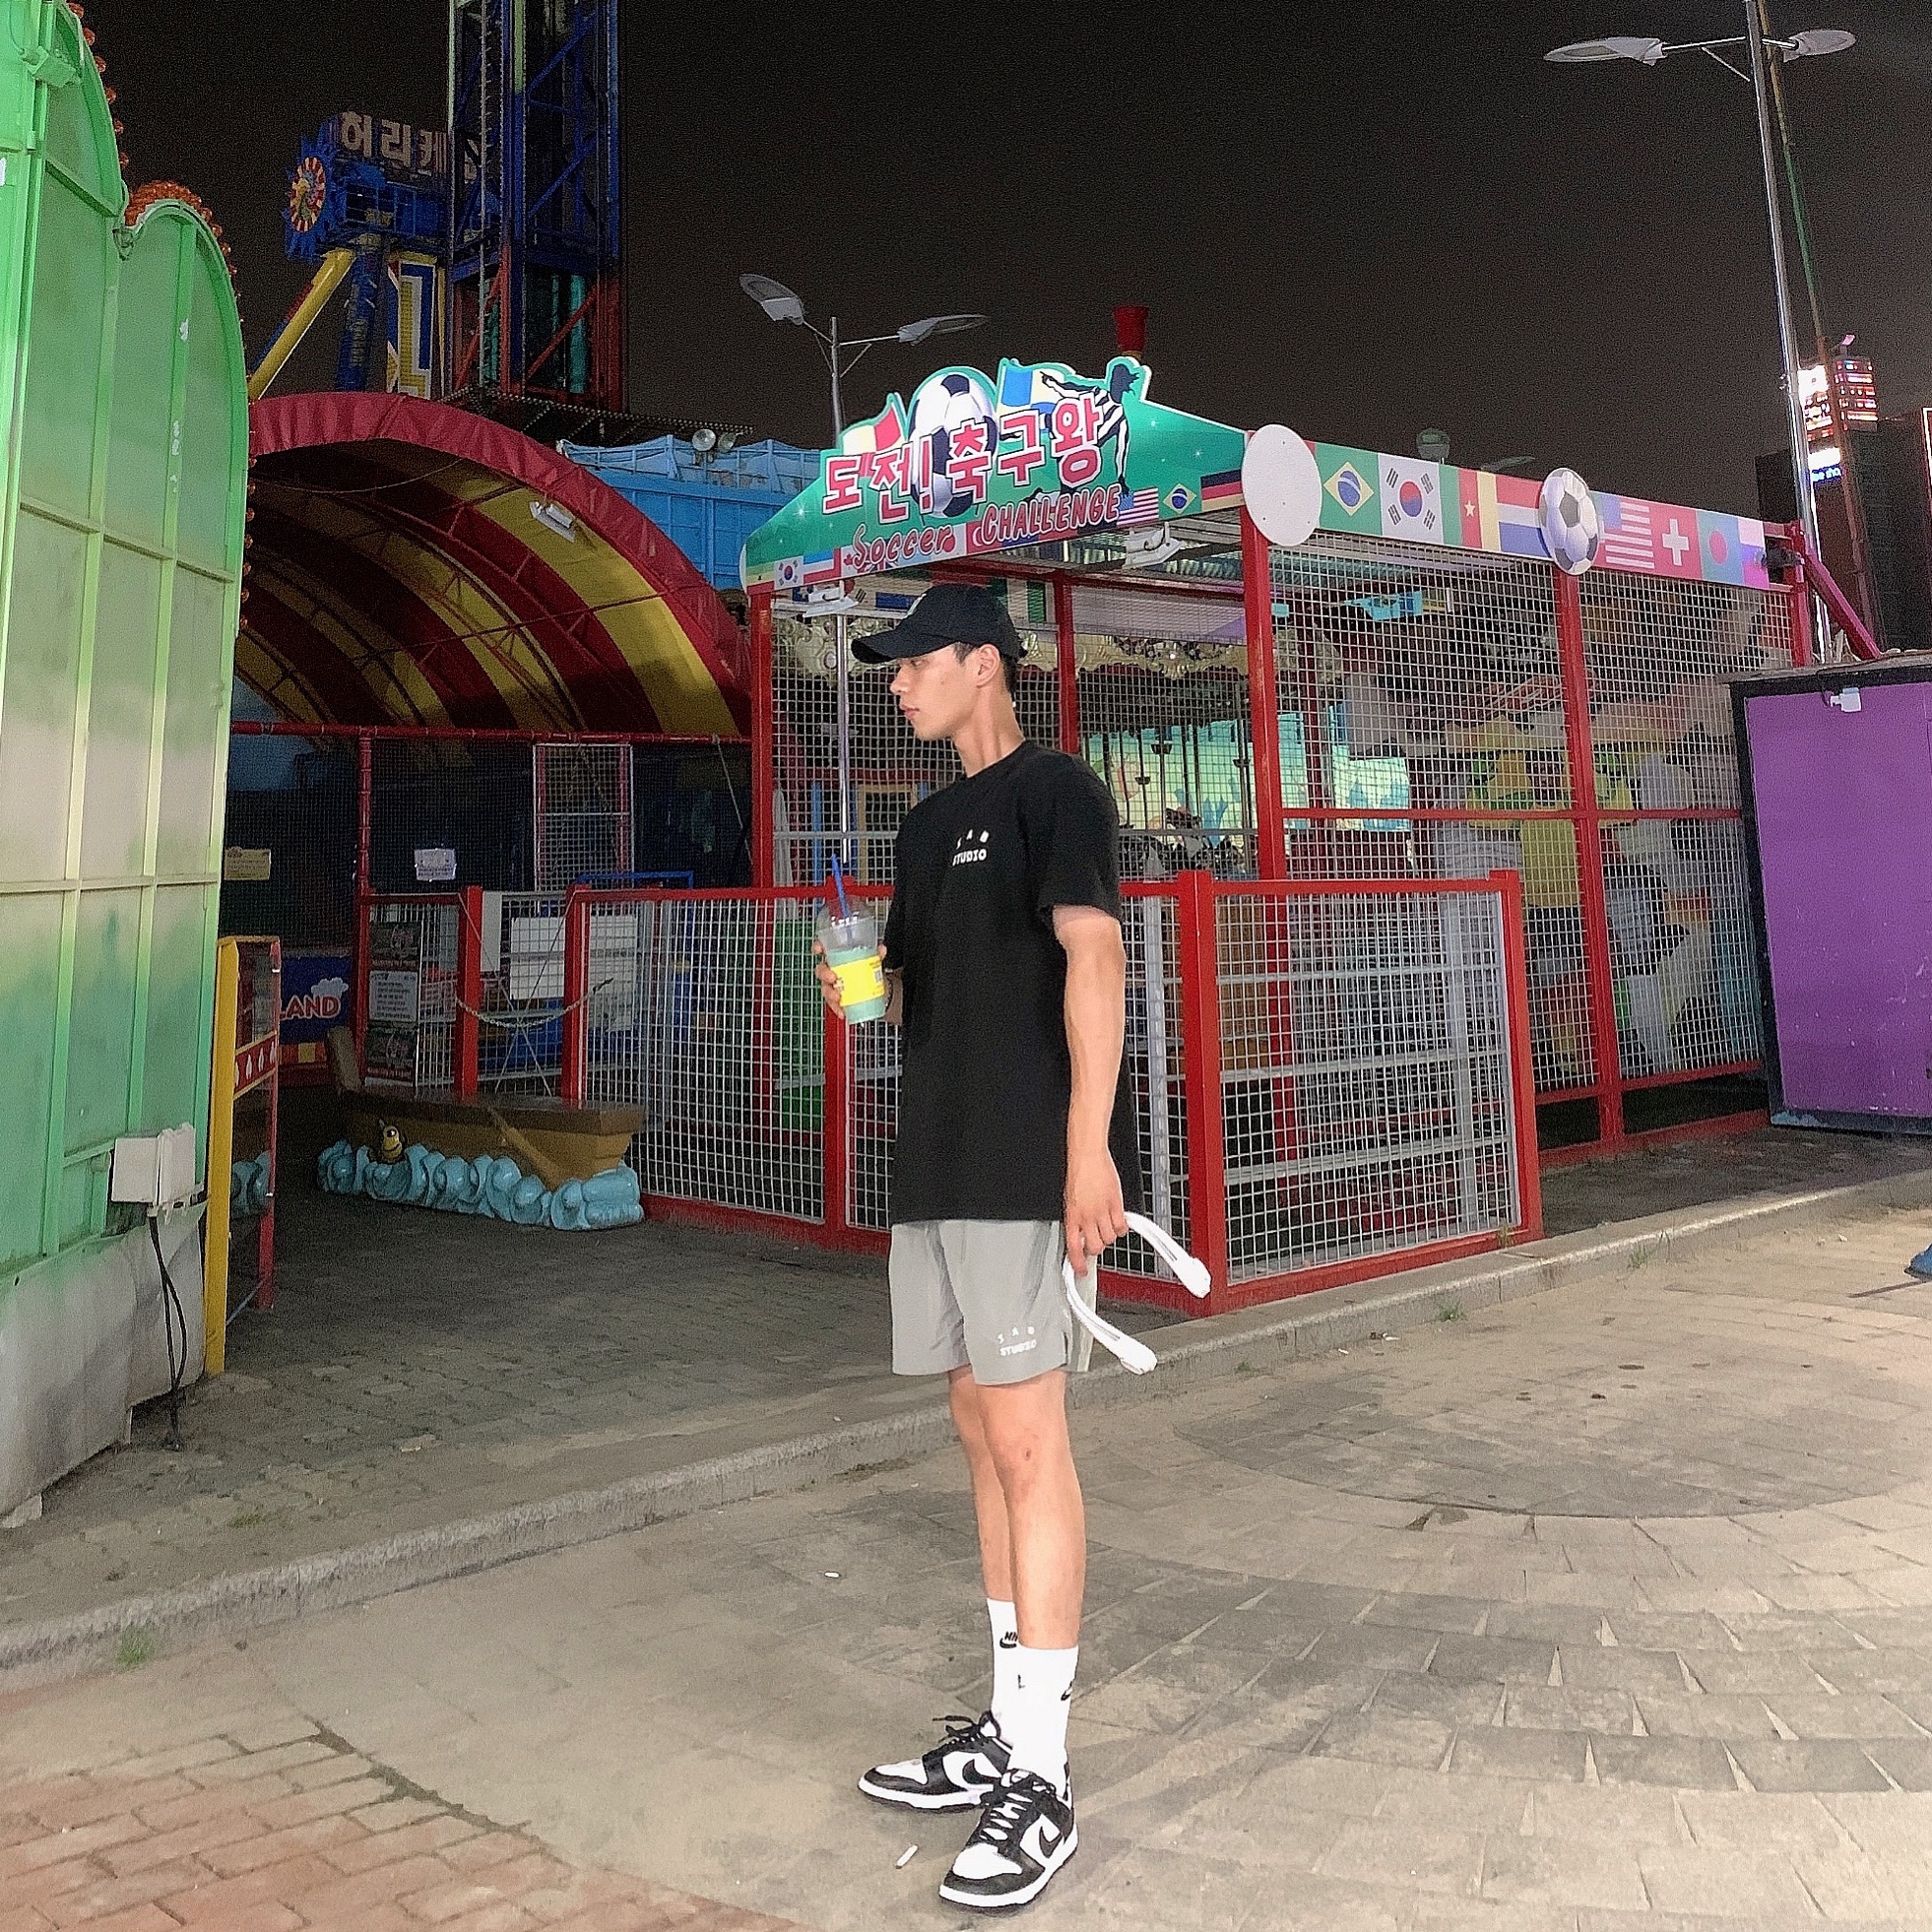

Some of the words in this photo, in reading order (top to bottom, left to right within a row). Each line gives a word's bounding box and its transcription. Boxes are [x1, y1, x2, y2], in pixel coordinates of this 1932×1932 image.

[341, 111, 479, 184] 허리케
[822, 434, 934, 524] 도전!
[945, 392, 1104, 504] 축구왕
[853, 523, 954, 569] Soccer
[982, 483, 1123, 545] CHALLENGE
[952, 848, 987, 867] STUDIO
[999, 1338, 1037, 1357] STUDIO
